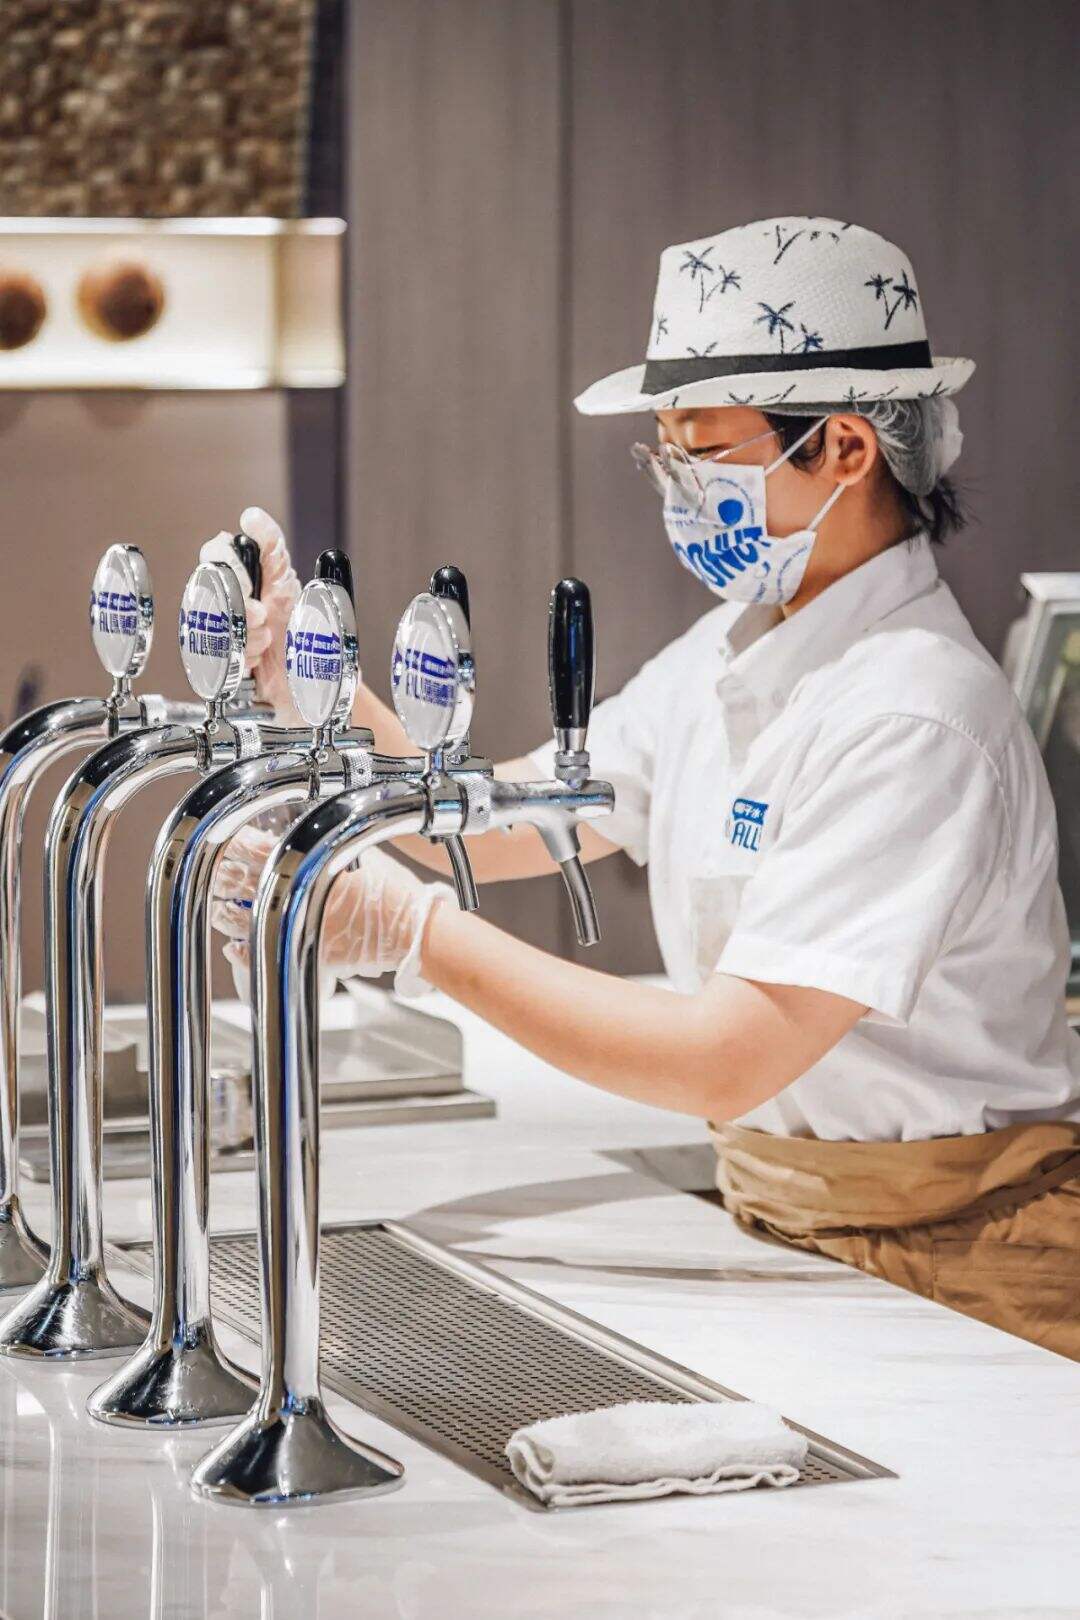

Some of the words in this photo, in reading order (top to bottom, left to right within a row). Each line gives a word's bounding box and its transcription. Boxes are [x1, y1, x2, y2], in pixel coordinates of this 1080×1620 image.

[189, 630, 204, 655] ALL
[297, 653, 313, 679] ALL
[731, 821, 757, 852] ALL
